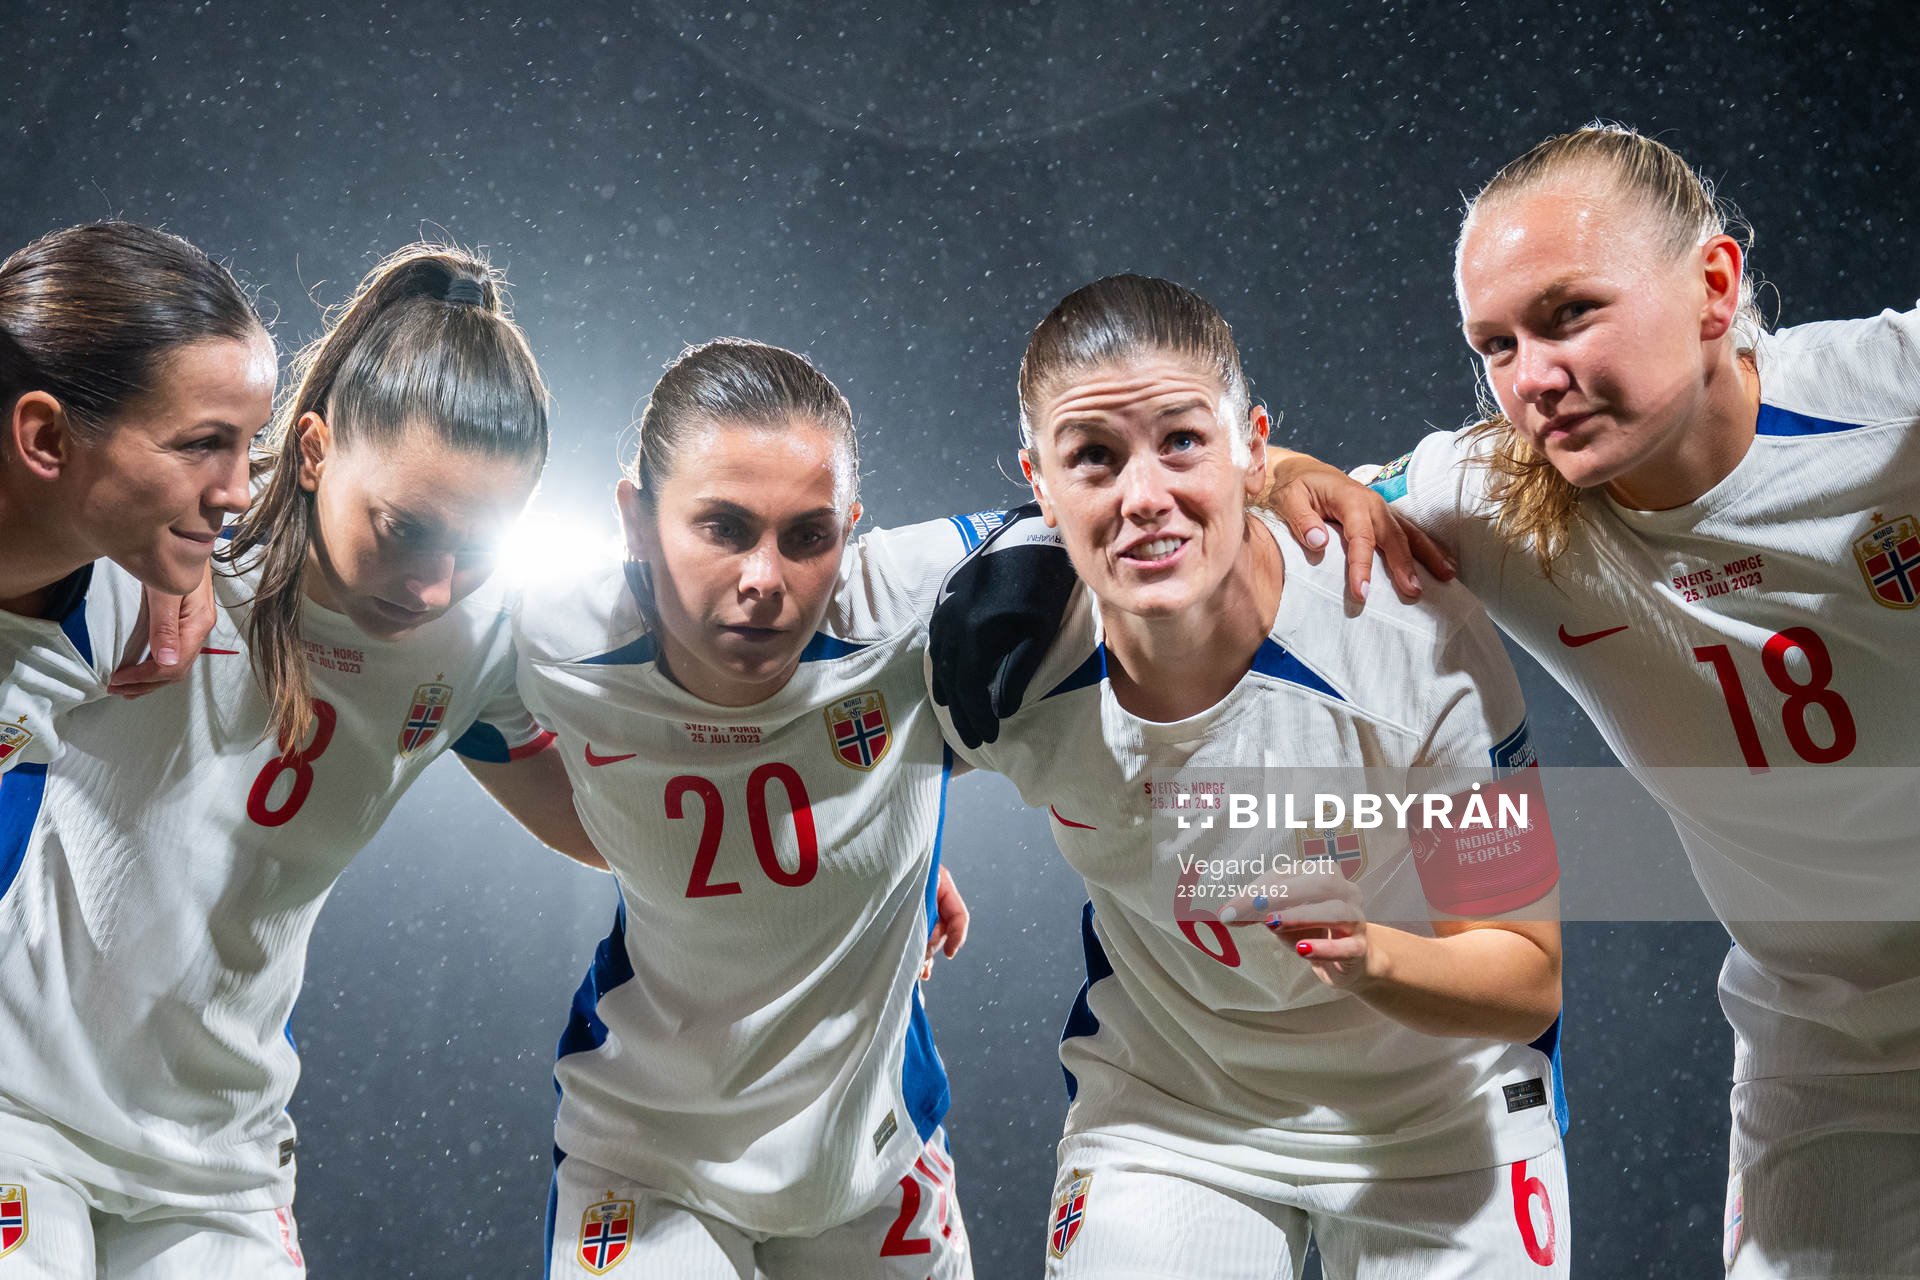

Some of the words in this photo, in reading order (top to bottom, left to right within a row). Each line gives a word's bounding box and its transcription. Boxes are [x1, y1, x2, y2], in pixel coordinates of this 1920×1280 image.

[1026, 534, 1065, 545] RWARM
[1873, 526, 1895, 541] NORGE
[1672, 569, 1713, 589] SVEITS
[1723, 554, 1764, 577] NORGE
[1683, 588, 1704, 603] 25.
[1706, 580, 1730, 598] JULI
[1731, 572, 1762, 591] 2023
[333, 647, 364, 662] NORGE
[1693, 626, 1857, 776] 18
[691, 732, 707, 743] 25.
[711, 734, 730, 744] JULI
[734, 734, 761, 744] 2023
[247, 697, 337, 827] 8
[1144, 782, 1180, 795] SVEITS
[1191, 782, 1225, 795] NORGE
[1195, 796, 1221, 809] 203
[664, 762, 819, 898] 20
[1457, 840, 1521, 865] PEOPLES
[1173, 863, 1241, 967] 6
[1511, 1160, 1555, 1267] 6
